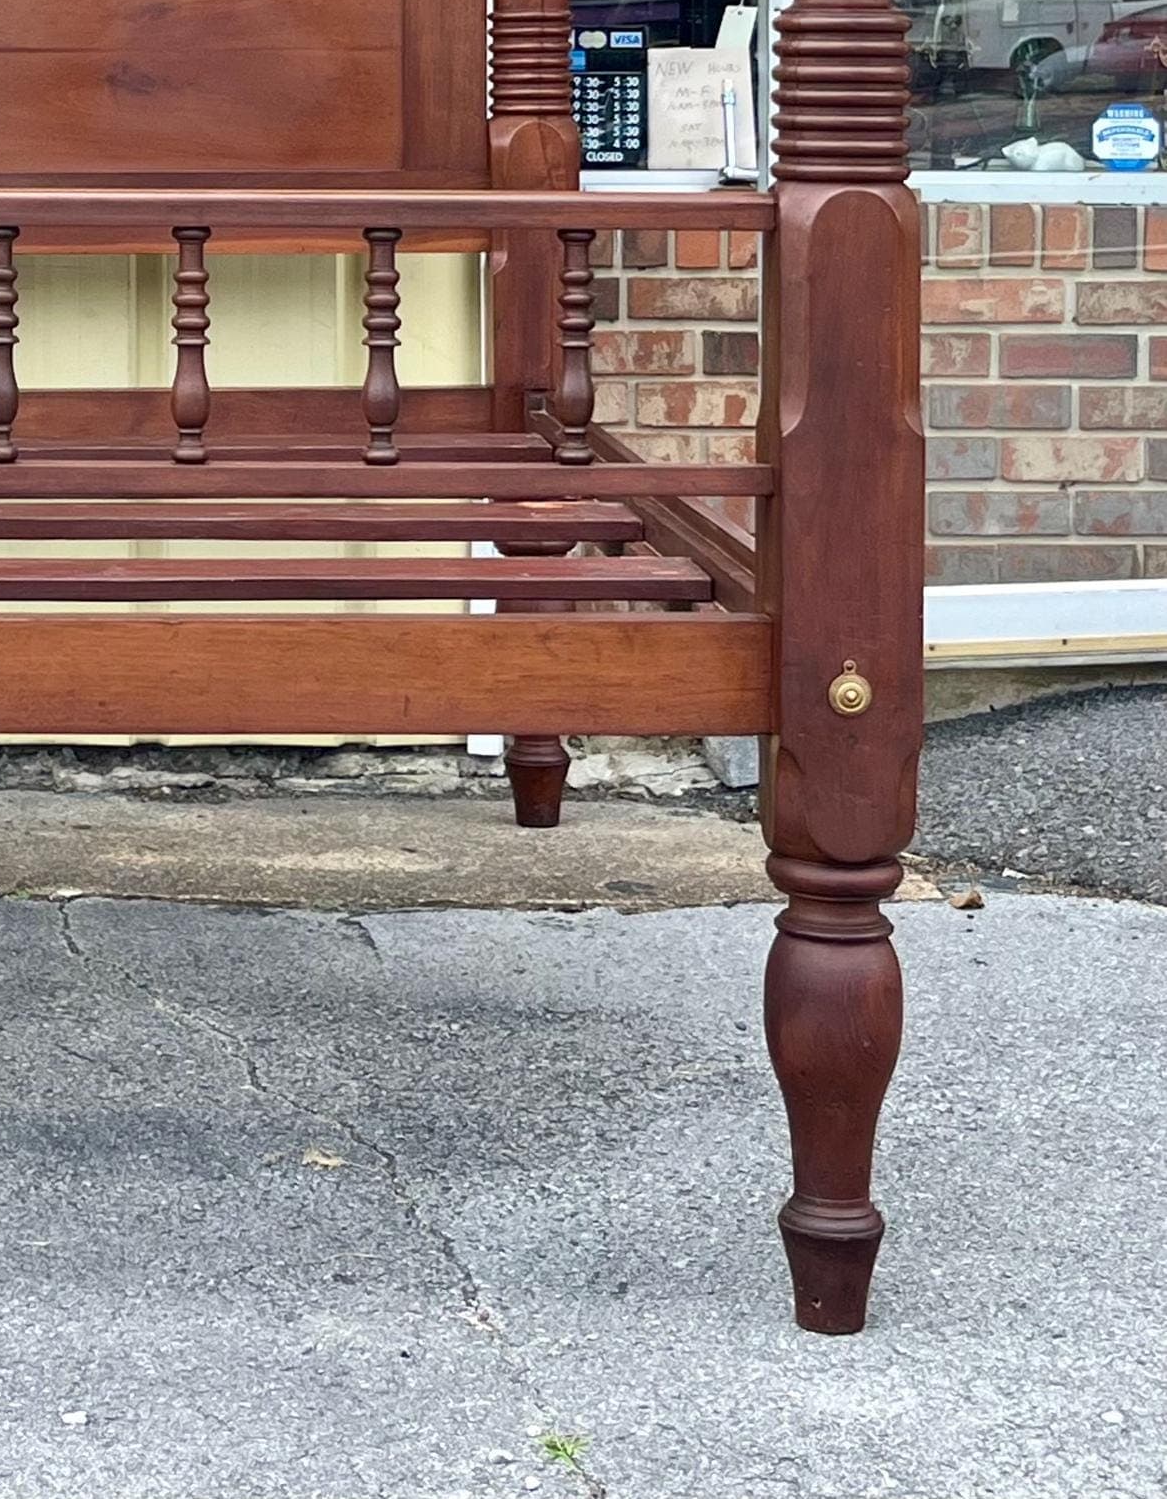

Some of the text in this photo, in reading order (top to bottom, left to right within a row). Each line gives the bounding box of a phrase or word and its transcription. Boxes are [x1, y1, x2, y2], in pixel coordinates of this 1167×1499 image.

[613, 35, 641, 45] VISA
[655, 60, 695, 77] NEW
[585, 151, 624, 162] CLOSED
